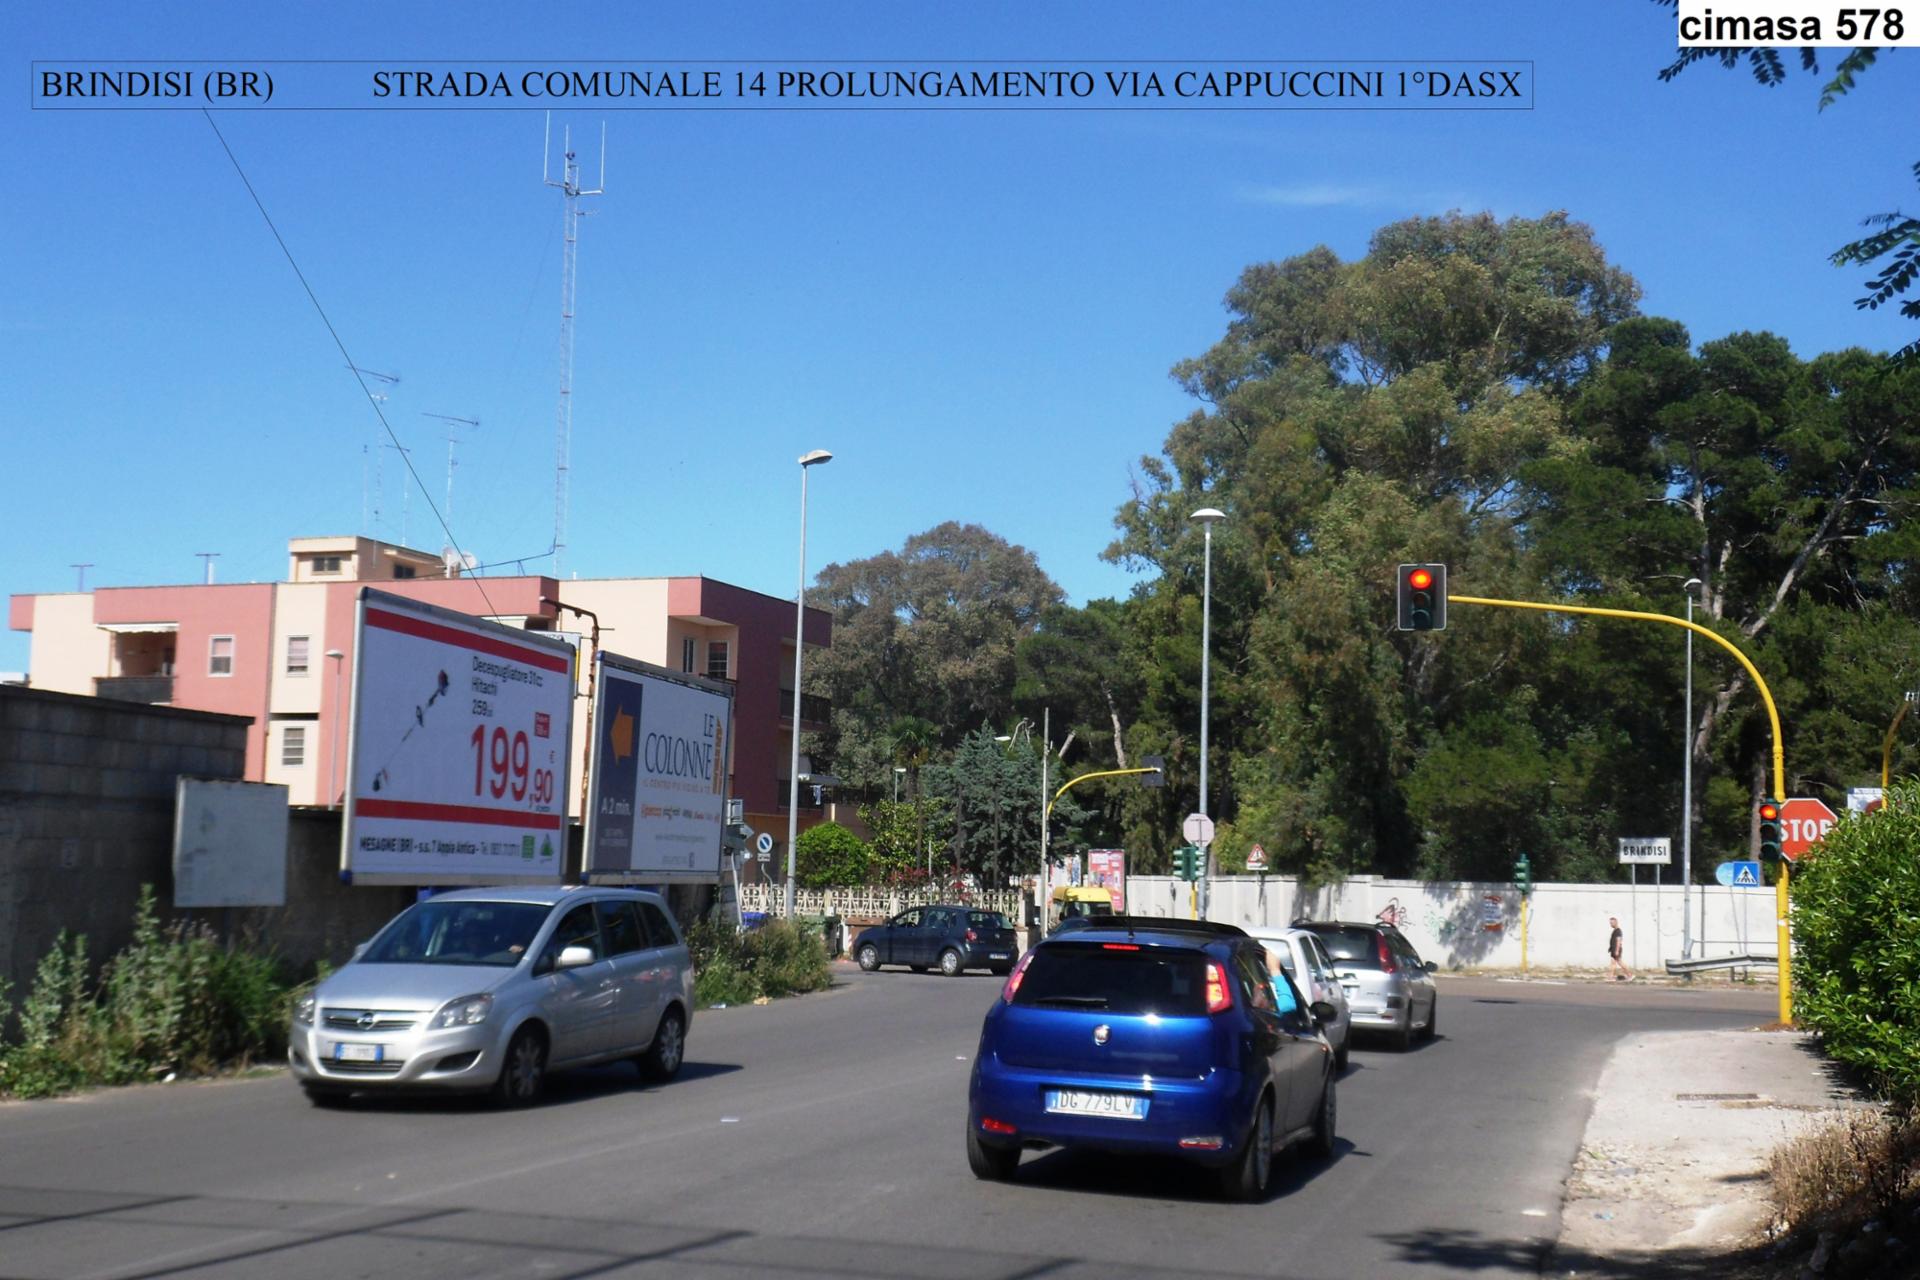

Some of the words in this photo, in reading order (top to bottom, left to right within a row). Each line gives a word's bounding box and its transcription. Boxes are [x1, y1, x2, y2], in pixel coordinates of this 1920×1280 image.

[704, 713, 714, 738] LE
[645, 732, 713, 780] COLONNE
[1623, 845, 1667, 857] BRINDISI
[1060, 1091, 1078, 1108] DG
